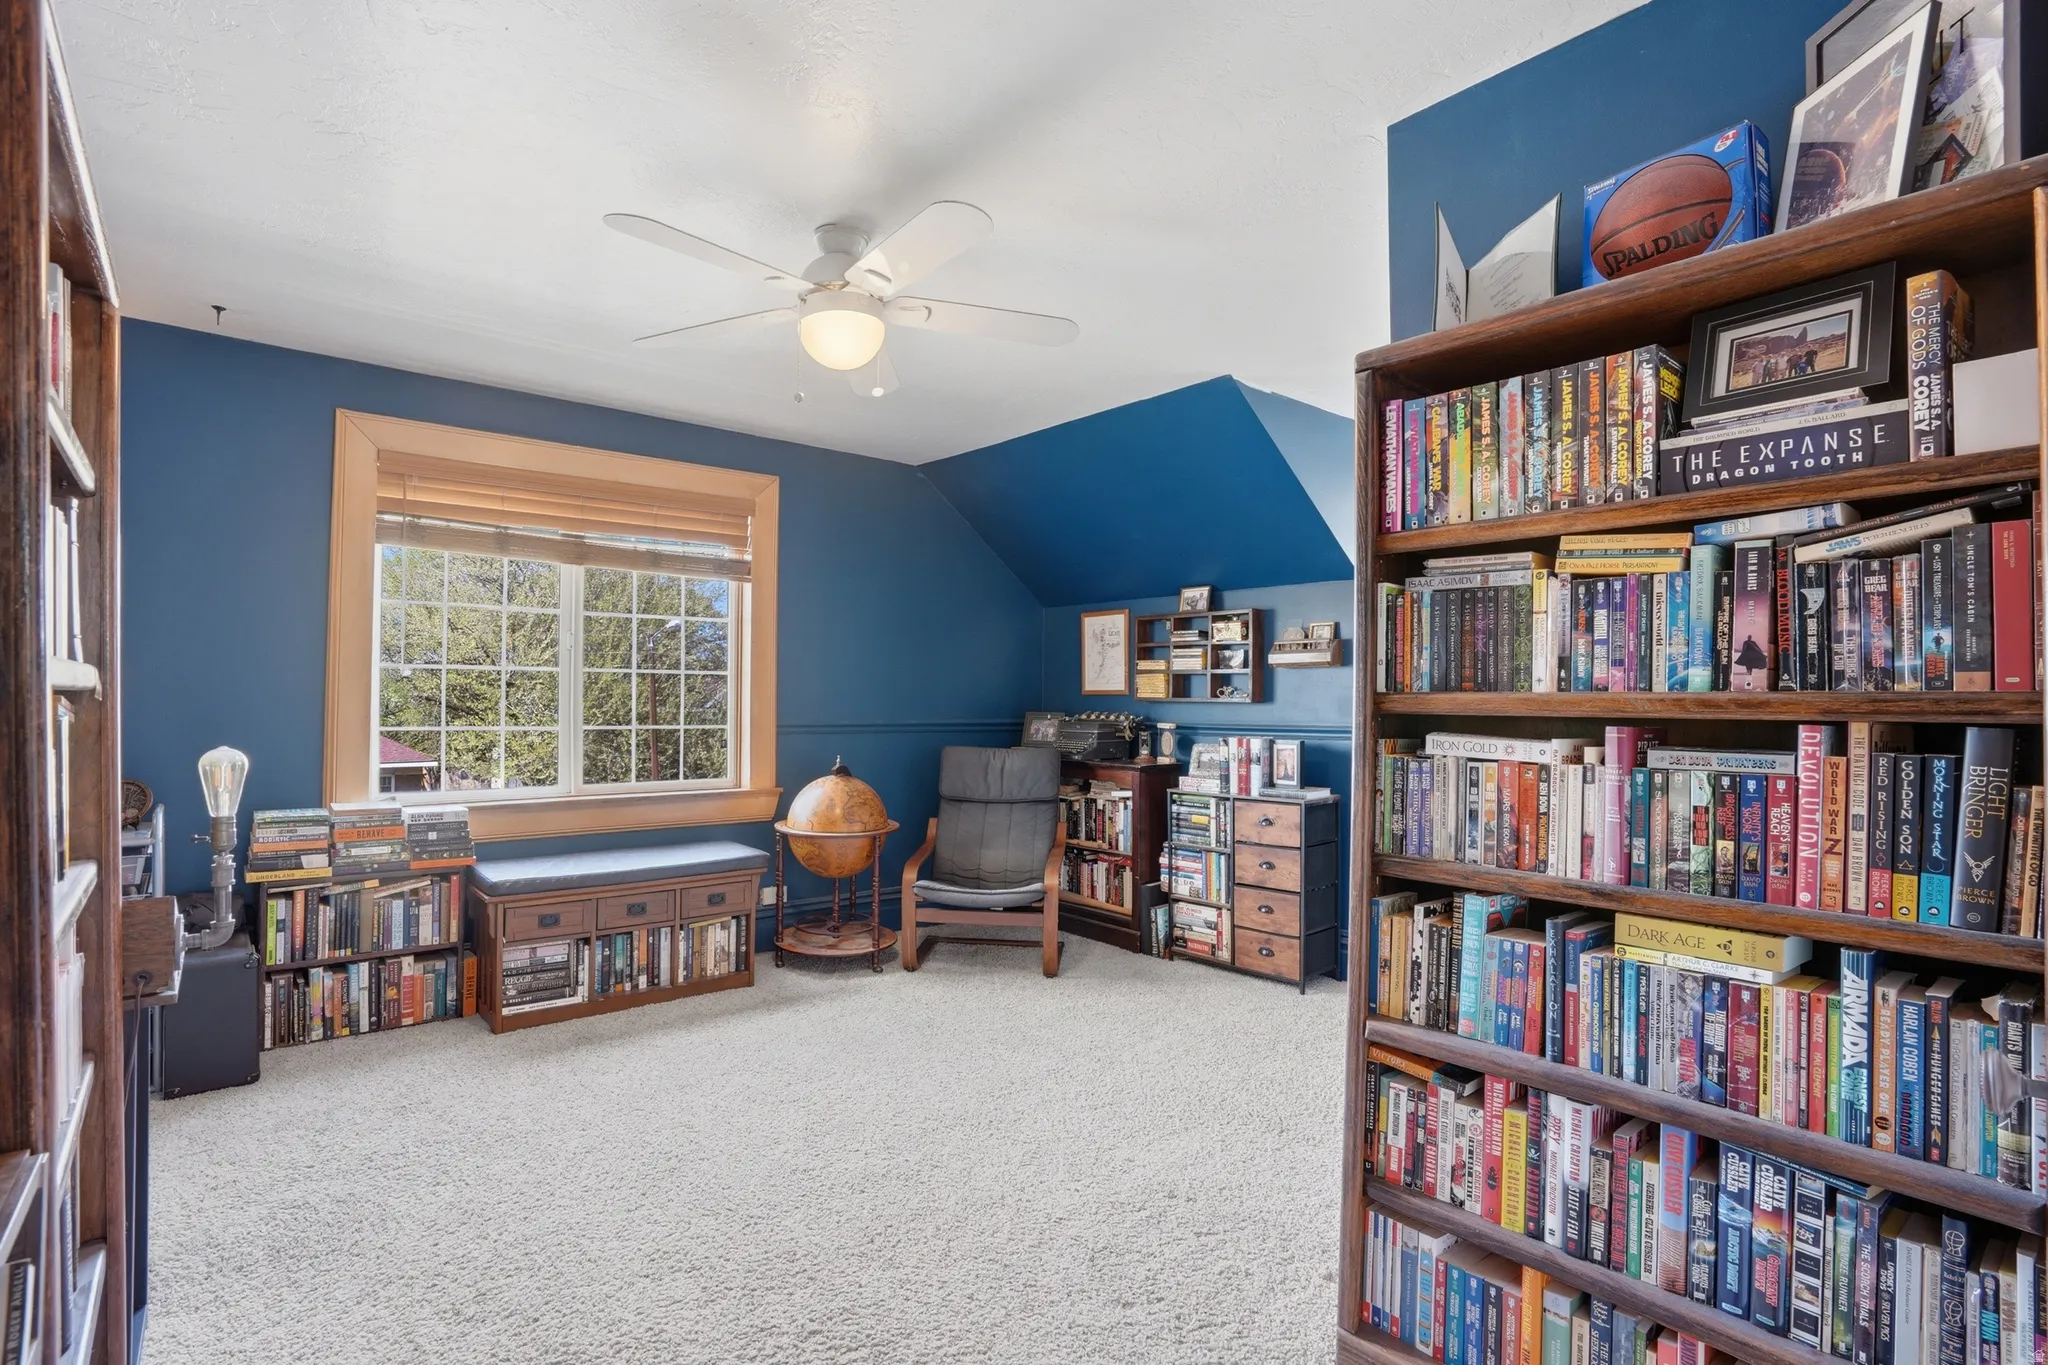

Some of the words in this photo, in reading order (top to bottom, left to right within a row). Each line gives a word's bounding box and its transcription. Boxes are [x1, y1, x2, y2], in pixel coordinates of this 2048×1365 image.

[1602, 212, 1719, 277] SPALDING
[1911, 305, 1926, 325] OF
[1927, 302, 1941, 325] THE
[1911, 328, 1927, 370] GODS
[1928, 327, 1941, 365] MERCY
[1562, 379, 1573, 420] JAMES
[1589, 371, 1599, 413] JAMES
[1617, 367, 1628, 409] JAMES
[1642, 362, 1653, 404] JAMES
[1930, 373, 1941, 405] JAMES
[1481, 396, 1490, 435] JAMES
[1533, 386, 1543, 427] JAMES
[1913, 375, 1930, 431] COREY
[1385, 405, 1397, 471] LEVIATHAN
[1431, 406, 1441, 464] CALIBAN'S
[1672, 449, 1723, 473] THE
[1740, 424, 1887, 464] EXPANSE
[1562, 451, 1572, 493] COREY
[1589, 445, 1600, 487] COREY
[1617, 442, 1628, 486] COREY
[1642, 436, 1653, 480] COREY
[1692, 464, 1776, 485] DRAGON
[1790, 451, 1863, 470] TOOTH
[1431, 466, 1441, 491] WAR
[1481, 465, 1491, 504] COREY
[1533, 457, 1543, 498] COREY
[1882, 515, 1901, 523] Man
[1927, 501, 1953, 511] Alfred
[1967, 545, 1975, 571] UNCLE
[1408, 579, 1436, 588] ISAAC
[1437, 576, 1475, 587] ASIMOV
[1777, 569, 1790, 612] BLOOD
[1864, 575, 1887, 584] GREG
[1864, 584, 1888, 593] BEAR
[1967, 572, 1975, 597] TOM'S
[1696, 586, 1704, 621] BACKMAN
[1967, 599, 1975, 623] CABIN
[1655, 622, 1664, 647] world
[1693, 627, 1704, 665] BEARTOWN
[1778, 613, 1791, 654] MUSIC
[1431, 738, 1460, 752] IRON
[1463, 740, 1498, 754] GOLD
[1668, 755, 1687, 766] BEN
[1688, 756, 1712, 767] BOVA
[1828, 761, 1840, 806] WORLD
[1853, 763, 1864, 787] VINCI
[1877, 757, 1889, 786] RED
[1932, 758, 1950, 819] MORNING
[1502, 787, 1511, 811] MARS
[1799, 731, 1821, 858] DEVOLUTION
[1852, 789, 1864, 809] CODE
[1900, 761, 1914, 820] GOLDEN
[1963, 765, 1988, 840] BRINGER
[1986, 766, 2009, 820] LIGHT
[1654, 790, 1662, 840] SUNDIVER
[1717, 807, 1725, 825] REEF
[1725, 793, 1735, 840] BRIGHTNESS
[1742, 807, 1751, 834] SHORE
[1751, 801, 1761, 842] INFINITY'S
[1771, 807, 1780, 836] REACH
[1780, 802, 1791, 842] HEAVEN'S
[1827, 808, 1840, 835] WAR
[1875, 792, 1887, 850] RISING
[356, 829, 385, 840] BEHAVE
[1825, 837, 1842, 856] Z
[1852, 837, 1863, 854] DAN
[1899, 825, 1913, 855] SON
[1931, 823, 1948, 861] STAR
[2031, 821, 2043, 862] INFINITIVE
[255, 872, 296, 881] UNDERLAND
[1851, 855, 1863, 883] BROWN
[1871, 871, 1880, 899] BROWN
[1880, 873, 1889, 899] PIERCE
[1906, 879, 1914, 904] PIERCE
[1936, 878, 1944, 904] PIERCE
[1956, 895, 1995, 906] BROWN
[1957, 886, 1995, 897] PIERCE
[1451, 897, 1464, 950] RETROGRADE
[1627, 923, 1669, 947] DARK
[1673, 933, 1706, 950] AGE
[504, 974, 534, 985] REGGIE
[1549, 929, 1558, 1020] EXHALATION
[1671, 955, 1701, 966] ARTHUR
[1711, 962, 1740, 973] CLARKE
[465, 973, 475, 1001] BEHAVE
[1813, 1012, 1824, 1043] NEEDLE
[1842, 968, 1868, 1068] ARMADA
[1879, 1008, 1891, 1047] READY
[1904, 1004, 1918, 1041] HARLAN
[1930, 1000, 1942, 1024] COLLINS
[2007, 1021, 2023, 1052] GIANTS
[1372, 1047, 1407, 1067] VICTORY
[1878, 1050, 1891, 1091] PLAYER
[1902, 1043, 1917, 1083] COBEN
[1930, 1052, 1942, 1093] HUNGER
[1813, 1064, 1822, 1098] CLEMENT
[1841, 1069, 1854, 1102] CLINE
[1852, 1066, 1868, 1113] ERNEST
[1393, 1091, 1401, 1114] MICHAEL
[1427, 1096, 1438, 1131] MICHAEL
[1494, 1082, 1504, 1116] MICHAEL
[1878, 1094, 1890, 1114] ONE
[1930, 1094, 1941, 1127] GAMES
[1391, 1113, 1400, 1137] CRICHTON
[1528, 1097, 1542, 1142] MICHAEL
[1548, 1115, 1562, 1146] PREY
[1571, 1106, 1583, 1142] MICHAEL
[1474, 1138, 1483, 1168] MICHAEL
[1491, 1117, 1503, 1157] CRICHTON
[1508, 1120, 1522, 1163] MICHAEL
[1665, 1132, 1685, 1165] CLIVE
[1425, 1144, 1437, 1184] CRICHTON
[1549, 1150, 1558, 1181] MICHAEL
[1569, 1144, 1581, 1183] CRICHTON
[1726, 1151, 1739, 1194] CUSSLER
[1738, 1160, 1750, 1190] CLIVE
[1473, 1169, 1482, 1205] CRICHTON
[1506, 1169, 1521, 1217] CRICHTON
[1527, 1166, 1540, 1219] CRICHTON
[1548, 1183, 1557, 1217] CRICHTON
[1567, 1184, 1579, 1210] STATE
[1645, 1182, 1655, 1215] ICEBERG
[1663, 1165, 1685, 1217] CUSSLER
[1759, 1163, 1774, 1212] CUSSLER
[1773, 1175, 1788, 1210] CLIVE
[1567, 1219, 1579, 1240] FEAR
[1590, 1221, 1604, 1251] TIMELINE
[1644, 1217, 1654, 1240] CLIVE
[1726, 1227, 1740, 1263] ARCTIC
[1643, 1240, 1654, 1275] CUSSLER
[1861, 1243, 1871, 1260] THE
[11, 1266, 25, 1307] ANGELL
[1726, 1263, 1739, 1294] DRIFT
[1755, 1257, 1767, 1293] DAWN
[1766, 1254, 1782, 1308] CRESCENT
[1860, 1261, 1871, 1296] SCORCH
[1879, 1268, 1888, 1294] DAVIS
[1886, 1261, 1895, 1294] LINDSEY
[1838, 1275, 1847, 1312] RUNNER
[7, 1306, 22, 1348] ROGER
[1859, 1298, 1869, 1328] TRIALS
[1881, 1299, 1891, 1325] SILVER
[1981, 1309, 1999, 1342] NOVA
[2001, 1298, 2017, 1333] NOVA
[1880, 1325, 1890, 1343] PIGS
